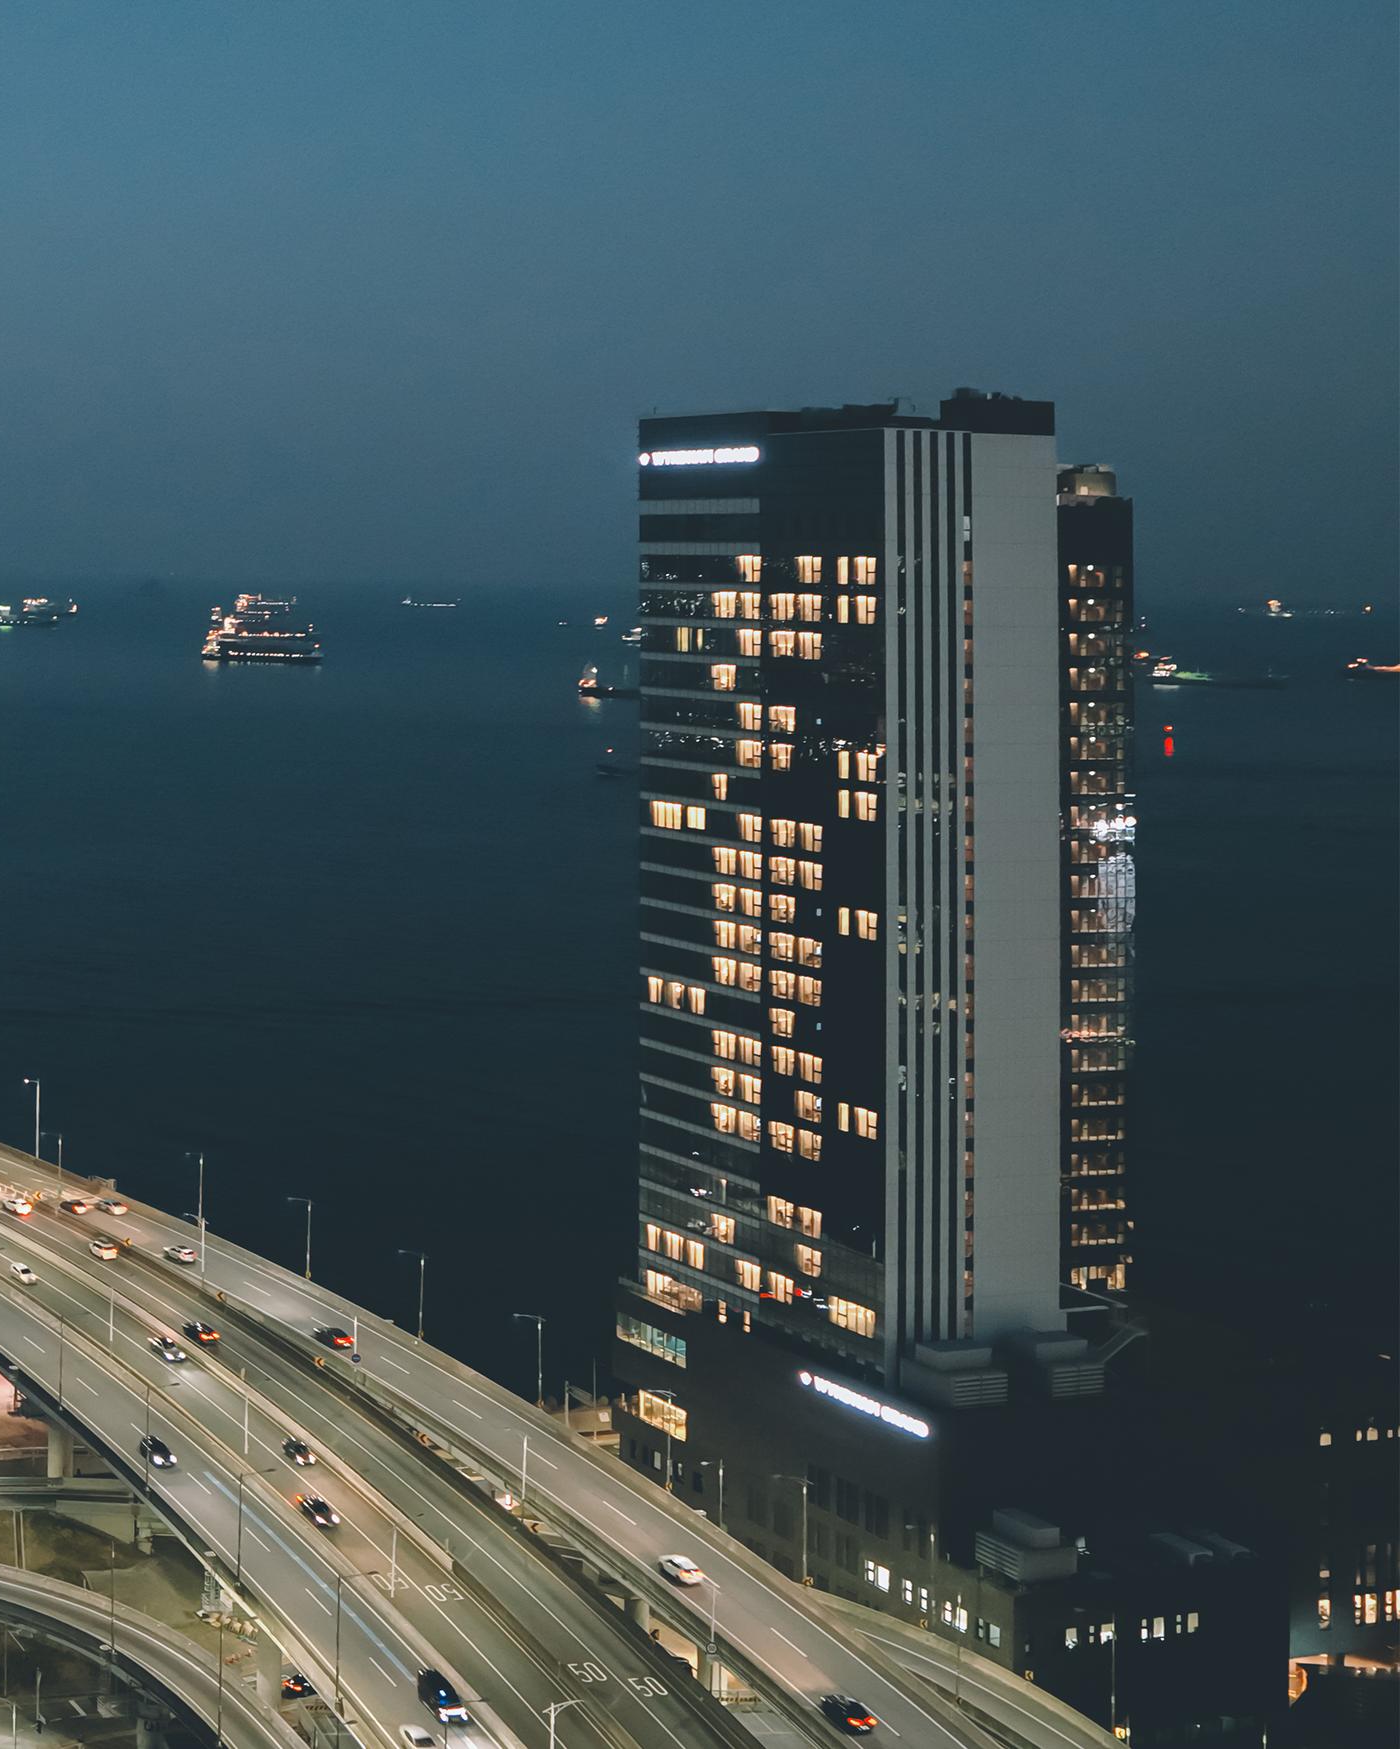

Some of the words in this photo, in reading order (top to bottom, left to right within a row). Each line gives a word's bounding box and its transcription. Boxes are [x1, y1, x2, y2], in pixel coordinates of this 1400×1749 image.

[371, 1573, 409, 1591] 50
[425, 1584, 464, 1602] 50
[567, 1662, 607, 1682] 50
[628, 1677, 668, 1697] 50
